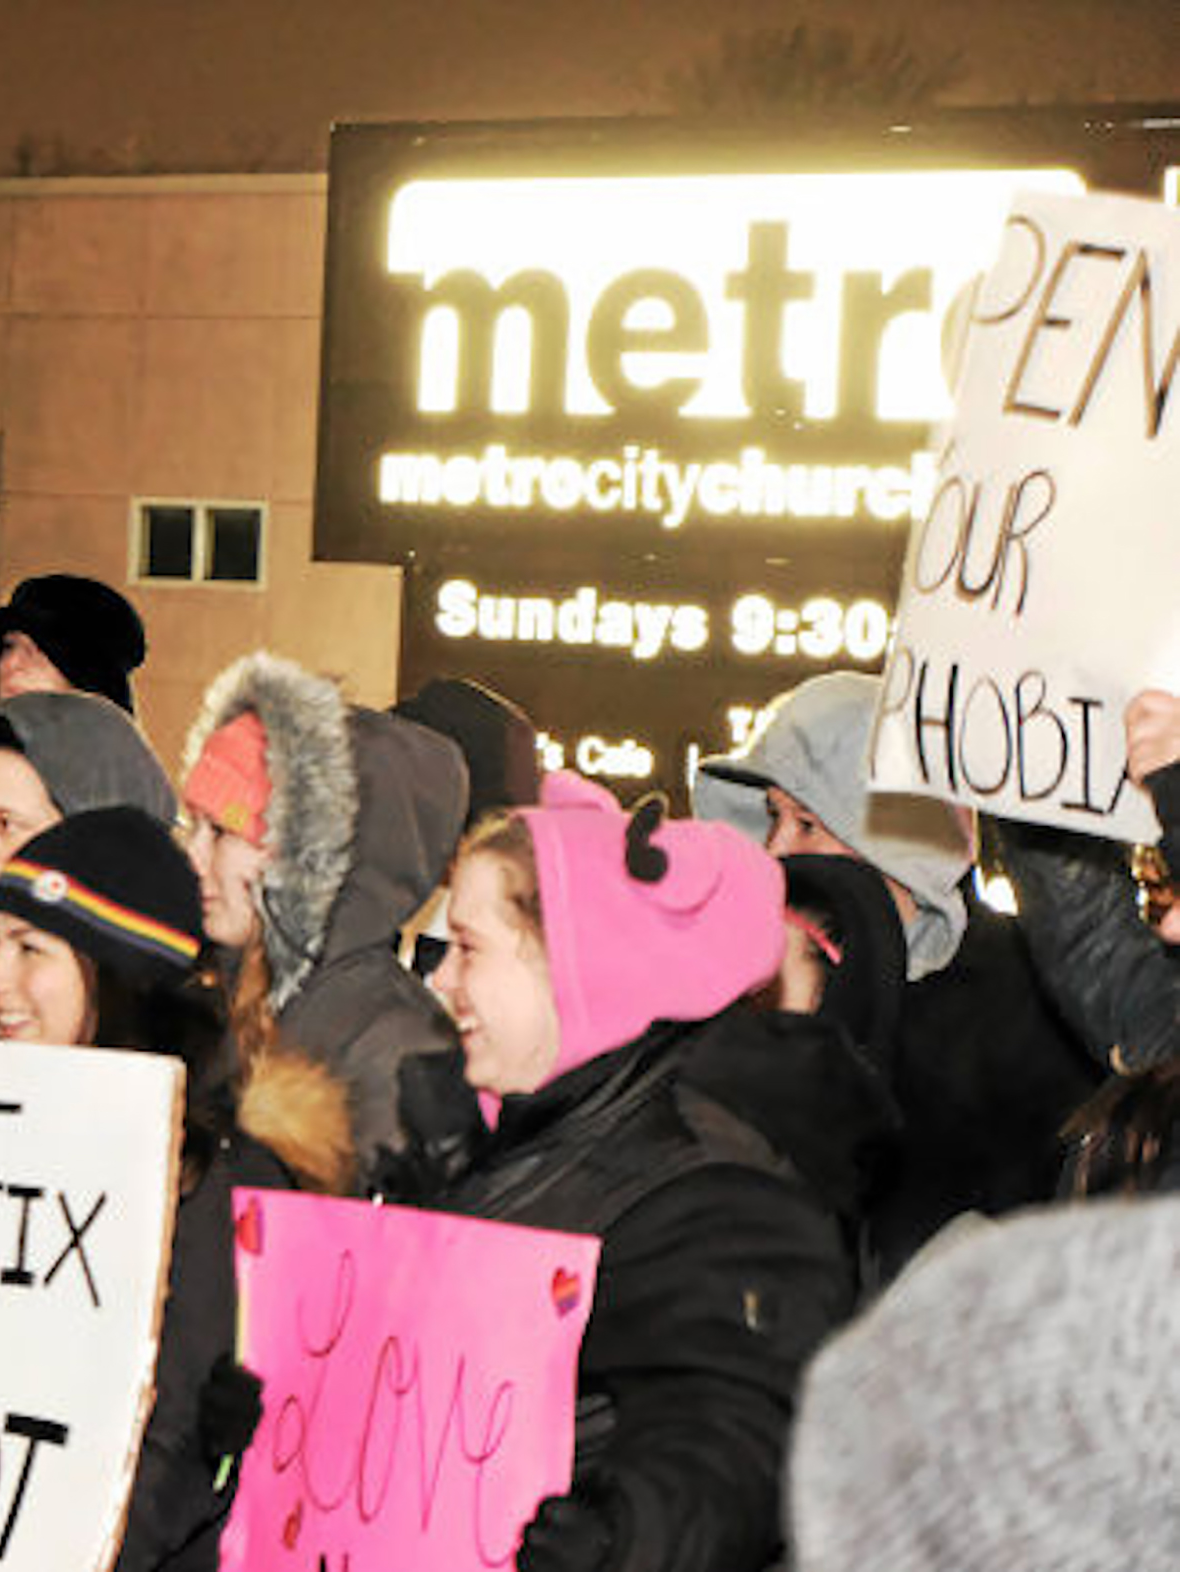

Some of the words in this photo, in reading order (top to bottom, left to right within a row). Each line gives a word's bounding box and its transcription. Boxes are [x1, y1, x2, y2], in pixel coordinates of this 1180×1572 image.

[386, 219, 978, 422] metr
[914, 440, 1056, 616] OUR
[436, 580, 709, 659] Sundays
[731, 594, 895, 660] 9:30
